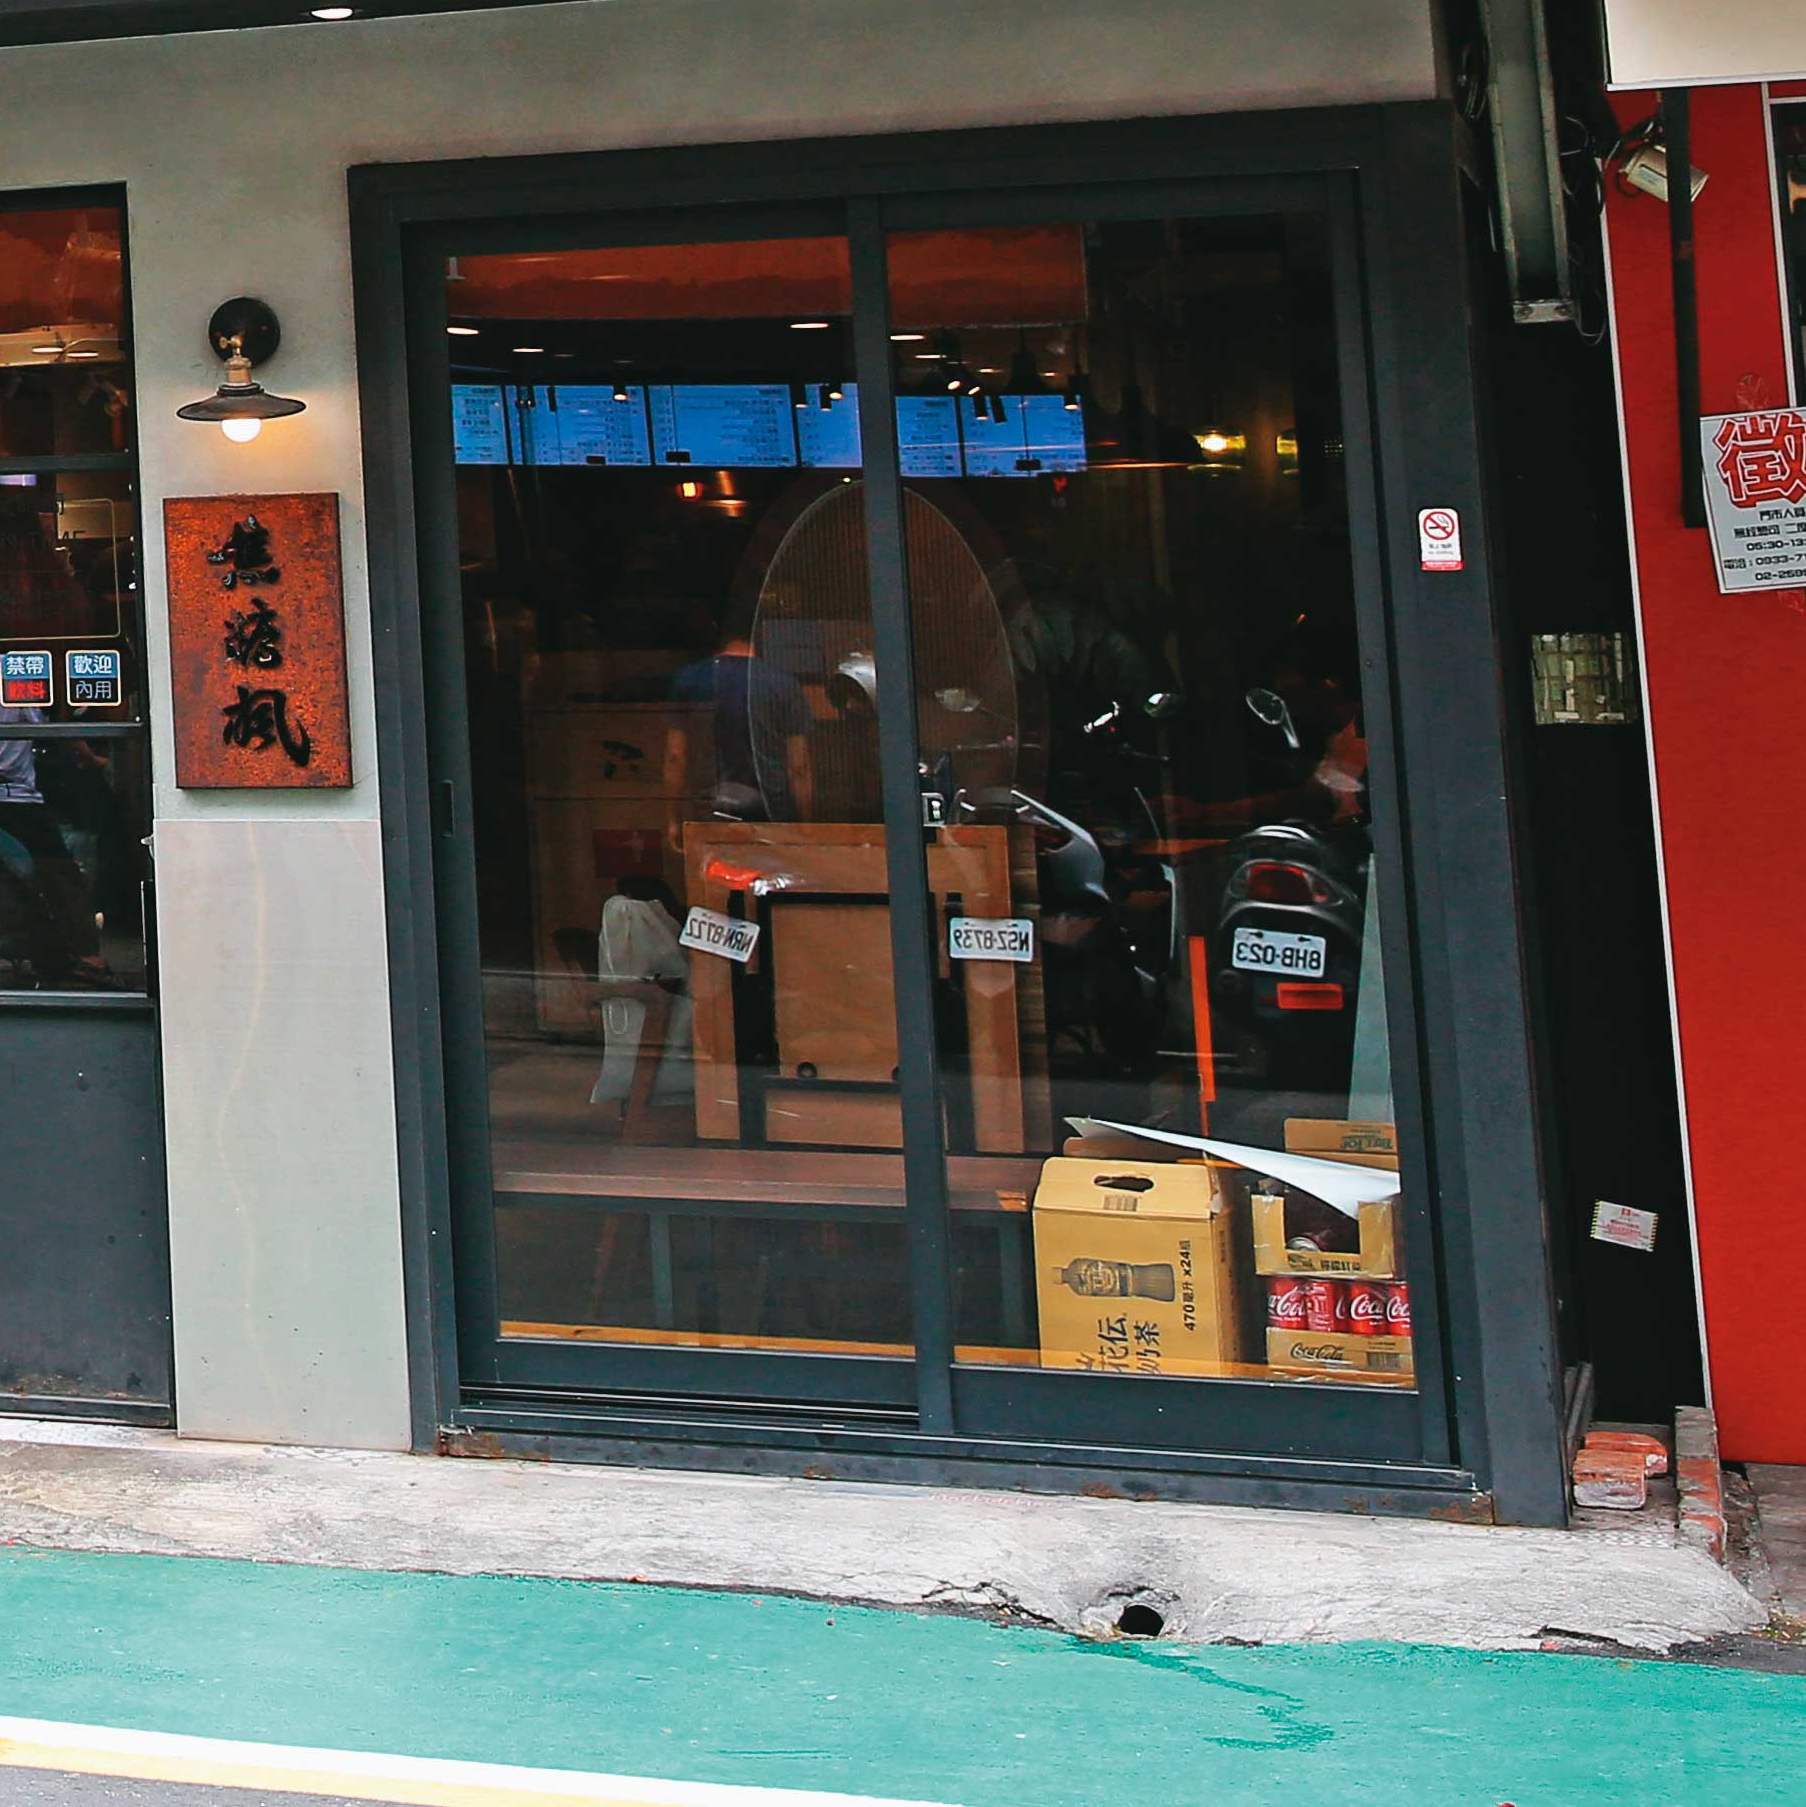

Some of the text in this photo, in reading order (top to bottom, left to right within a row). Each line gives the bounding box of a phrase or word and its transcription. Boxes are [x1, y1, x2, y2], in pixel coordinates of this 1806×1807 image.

[206, 513, 312, 767] 焦糖楓
[6, 655, 45, 675] 禁帶
[73, 654, 113, 675] 歡迎
